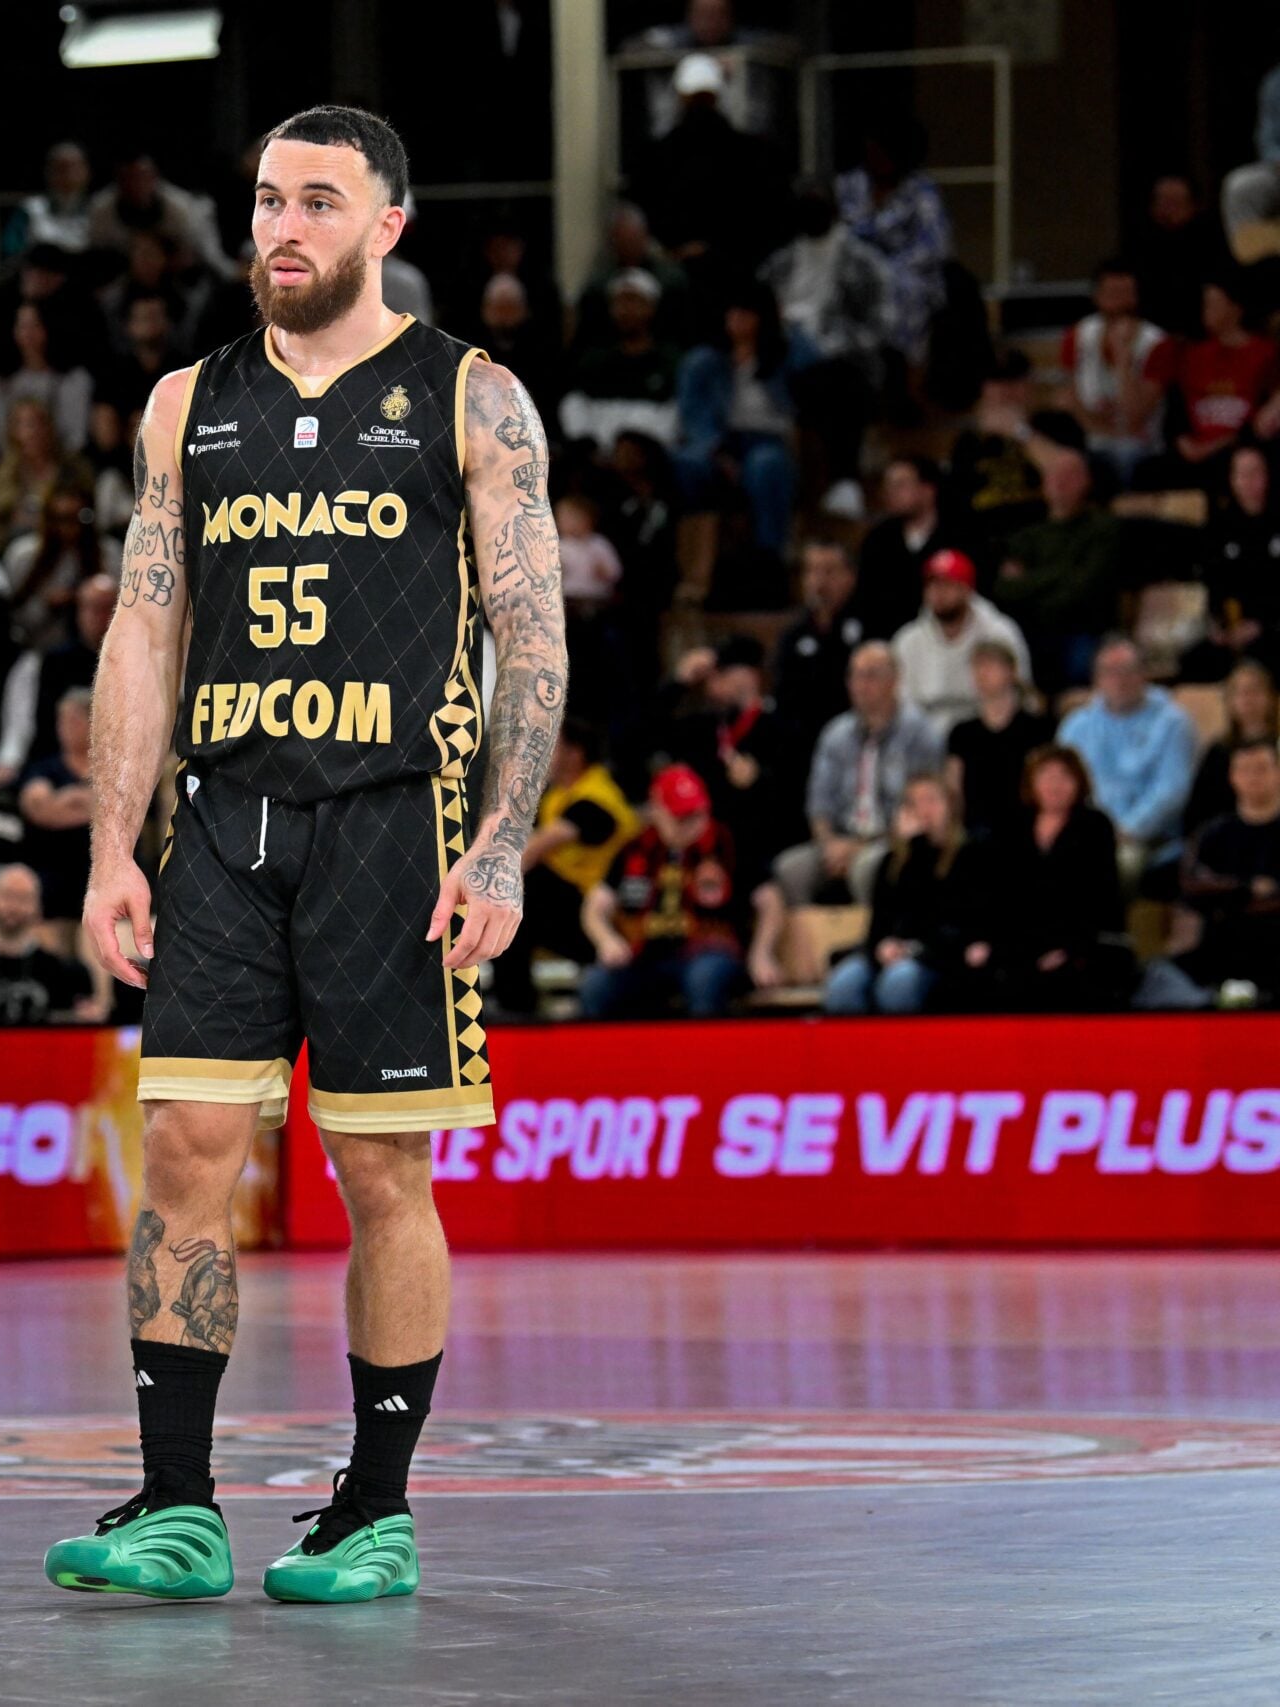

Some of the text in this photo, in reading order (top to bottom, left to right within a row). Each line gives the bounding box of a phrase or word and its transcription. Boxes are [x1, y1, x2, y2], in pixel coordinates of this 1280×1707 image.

[197, 421, 238, 436] SPALDING
[358, 433, 420, 447] MICHEL PASTOR
[370, 425, 407, 437] GROUPE
[202, 490, 408, 546] MONACO
[248, 564, 329, 648] 55
[192, 679, 392, 744] FEDCOM
[381, 1065, 428, 1080] SPALDING
[492, 1095, 701, 1182] SPORT
[713, 1091, 845, 1179] SE
[855, 1090, 1025, 1176] VIT
[1028, 1088, 1280, 1176] PLUS
